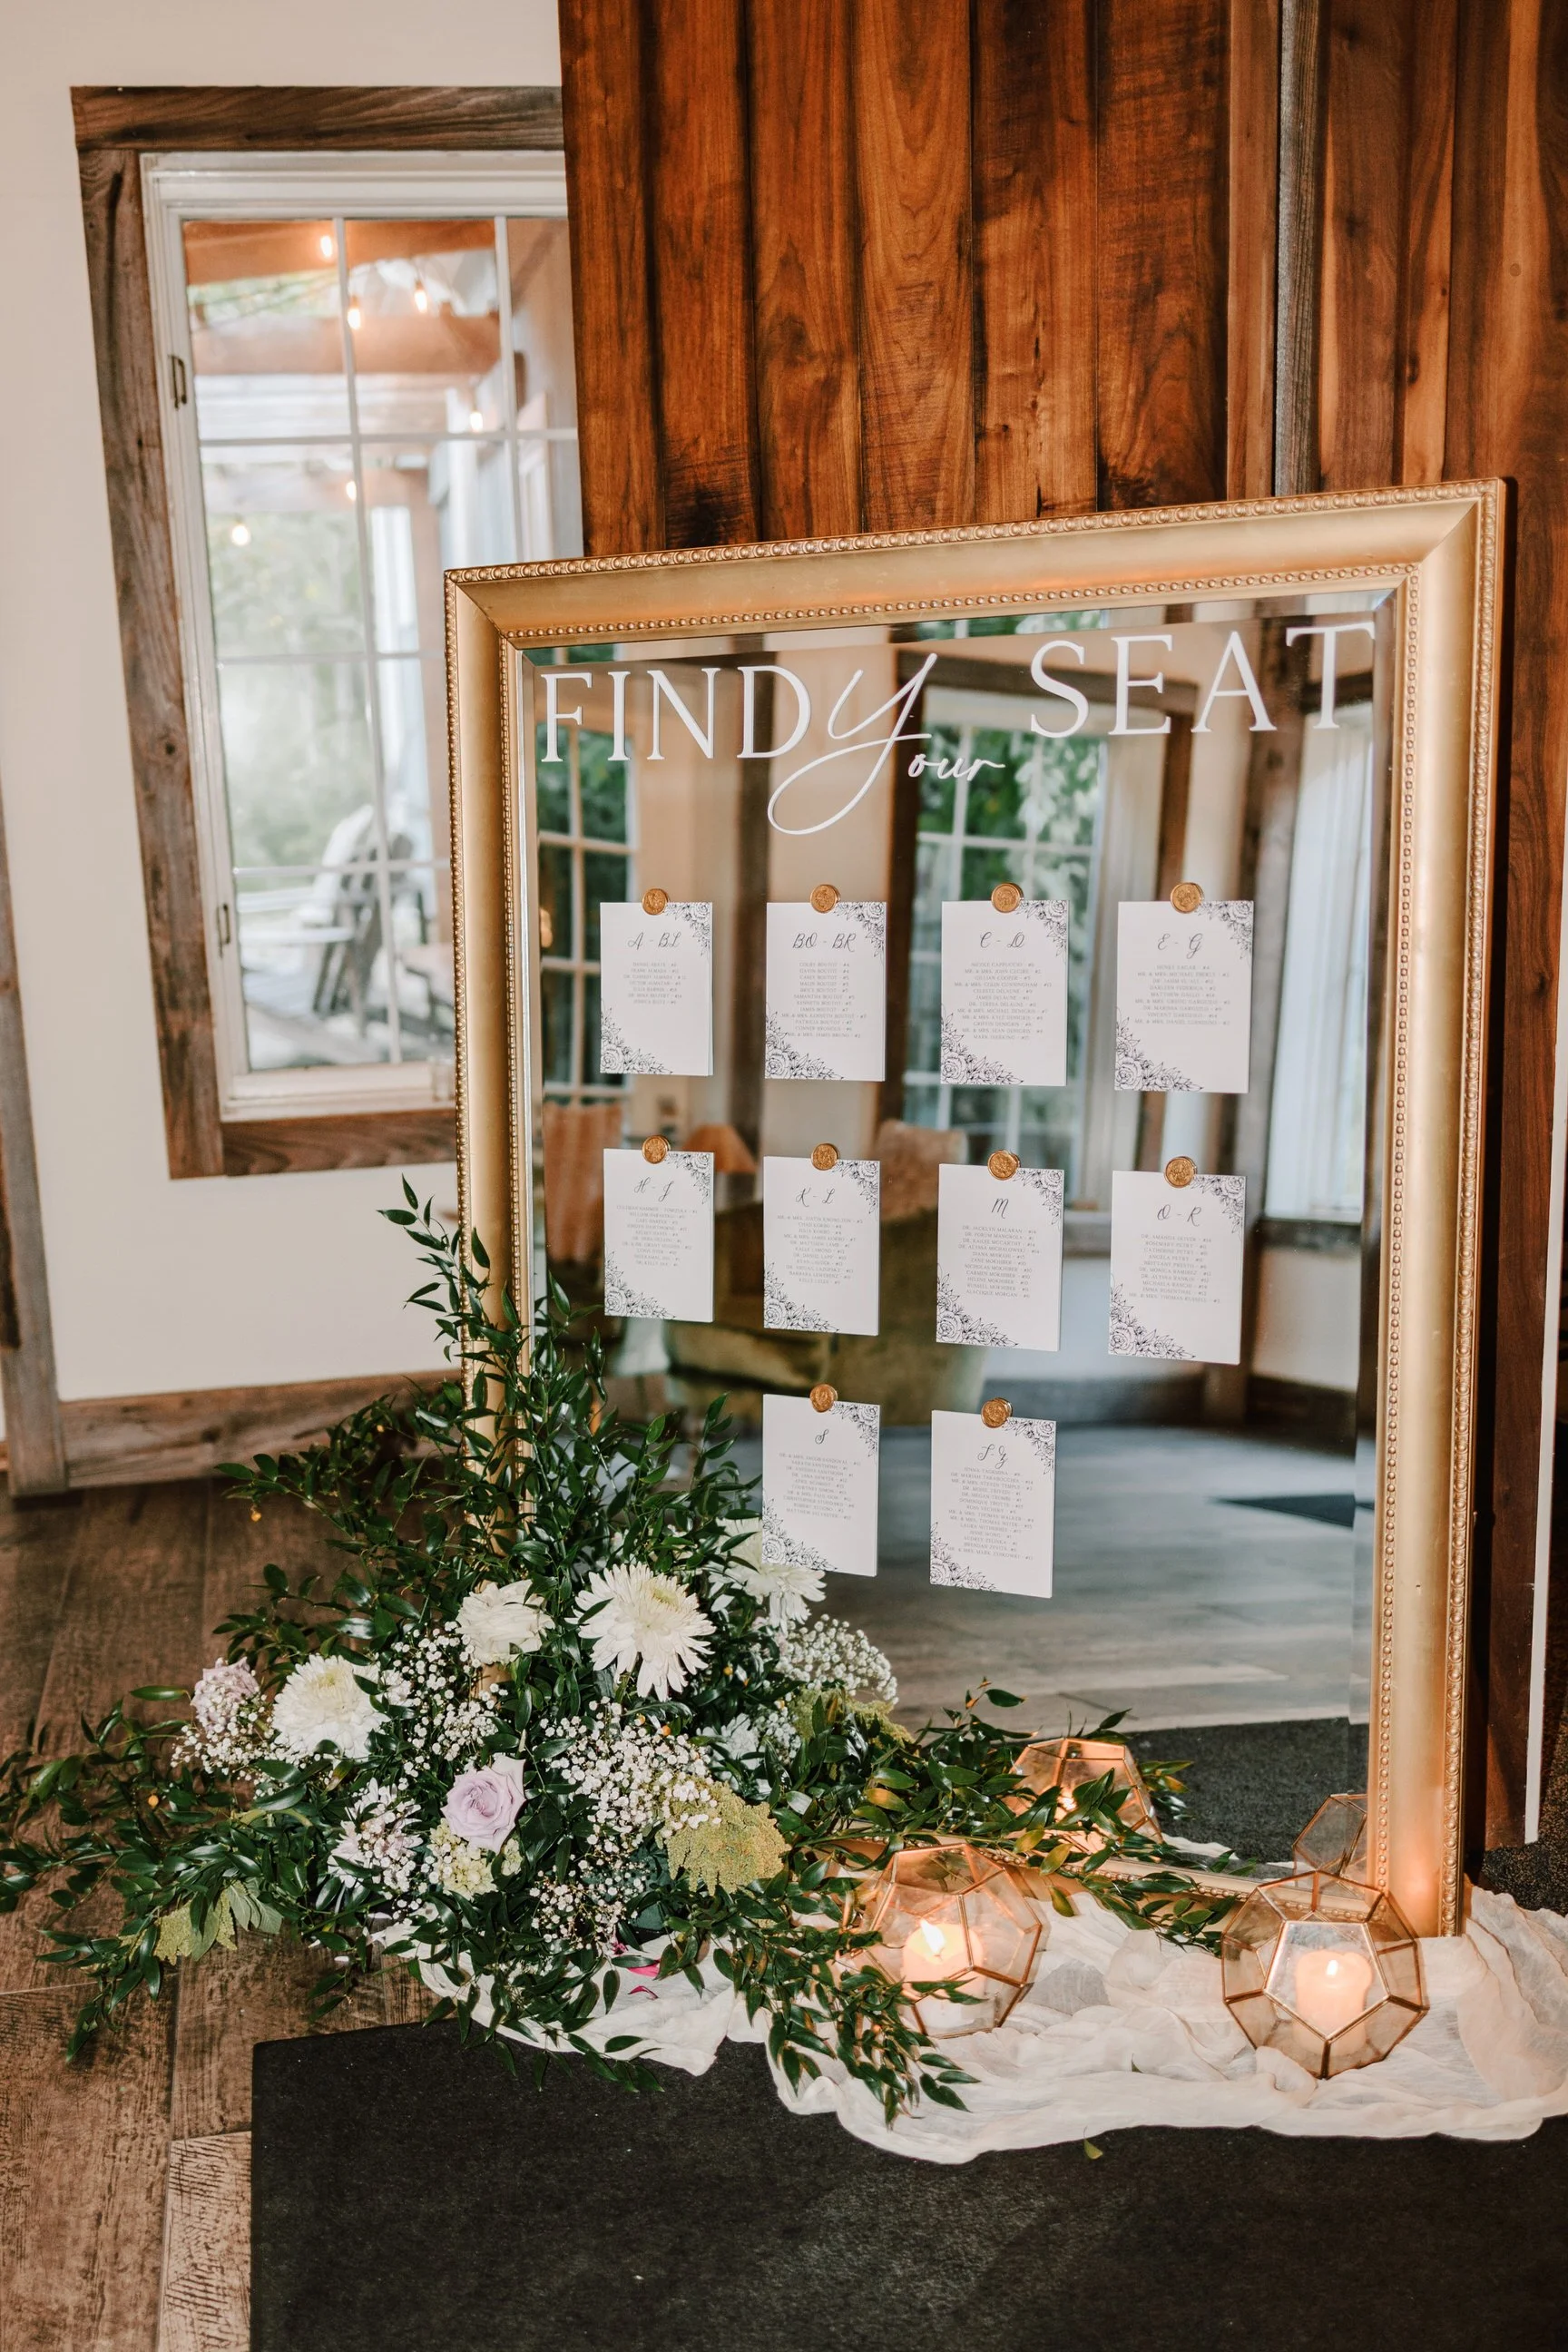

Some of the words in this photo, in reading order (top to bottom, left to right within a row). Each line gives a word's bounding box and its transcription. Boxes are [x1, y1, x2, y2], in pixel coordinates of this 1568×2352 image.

[541, 664, 812, 763] FIND
[1030, 622, 1376, 739] SEAT
[627, 931, 643, 950] A
[792, 932, 818, 949] BO
[832, 933, 857, 953] BR
[980, 931, 992, 948] C
[1157, 933, 1171, 951] E
[991, 1198, 1009, 1219] M
[1186, 1206, 1202, 1227] R
